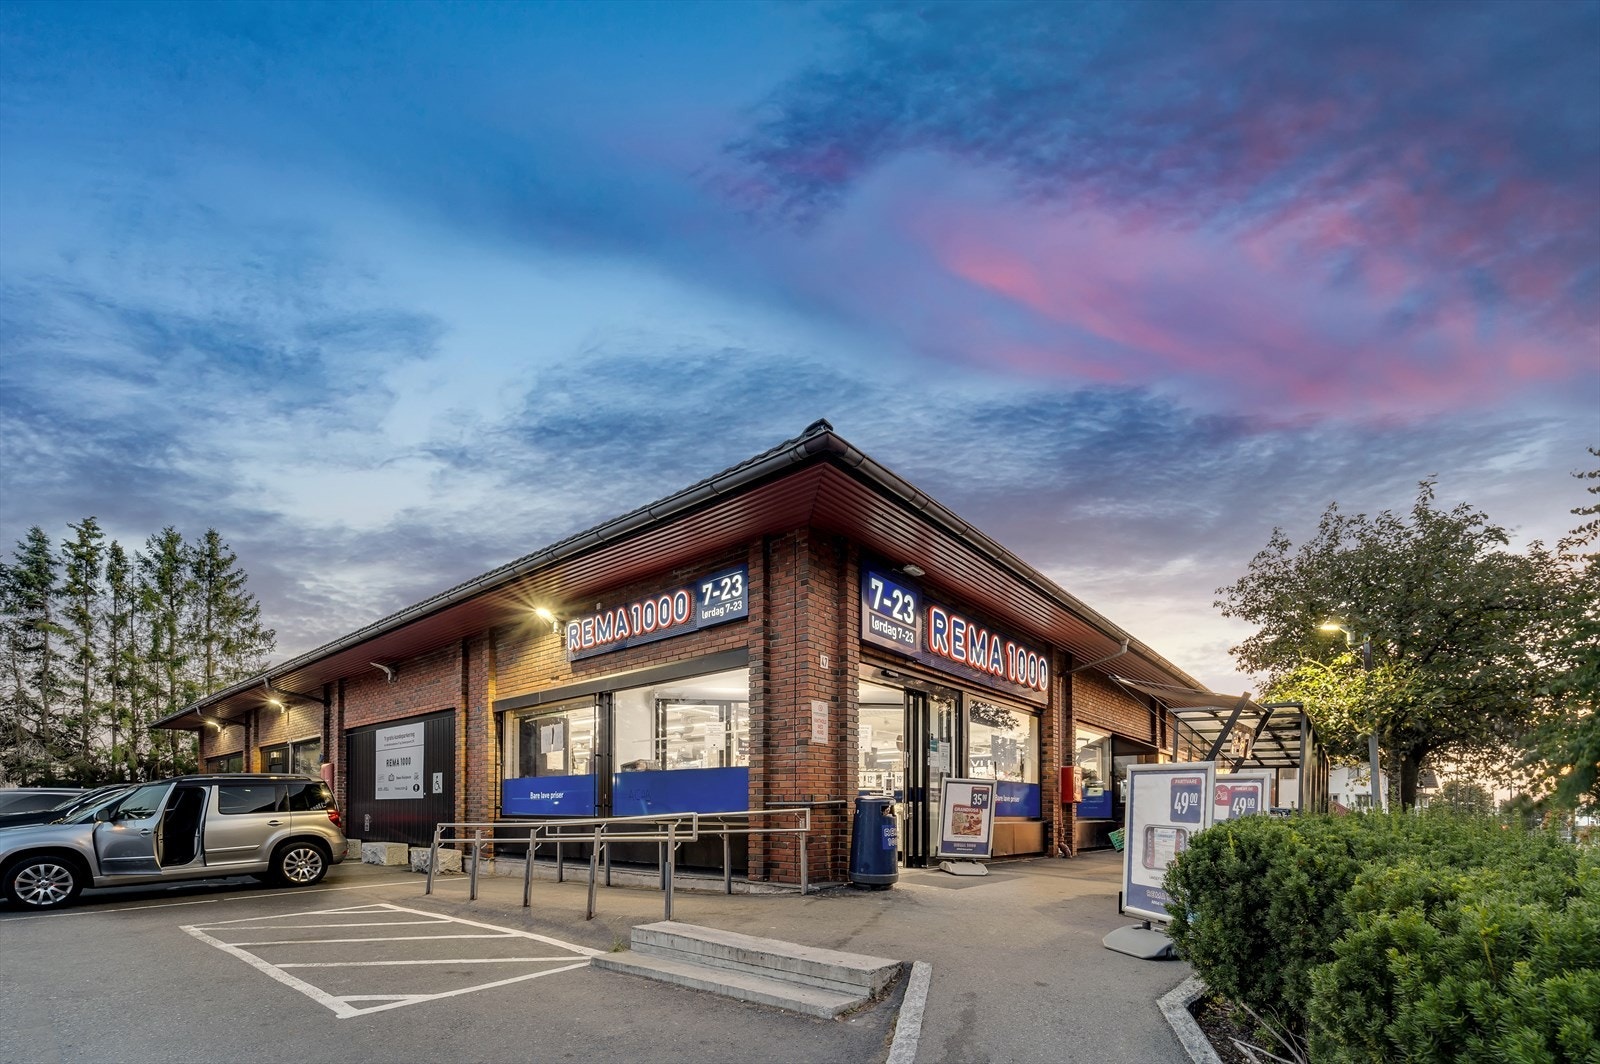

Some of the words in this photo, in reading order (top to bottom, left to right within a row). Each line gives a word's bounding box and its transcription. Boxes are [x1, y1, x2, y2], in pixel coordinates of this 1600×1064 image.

[702, 574, 742, 606] 7-23
[871, 578, 915, 624] 7-23
[567, 607, 631, 650] REMA
[631, 590, 692, 635] 1000
[701, 603, 724, 619] lørdag
[725, 600, 743, 613] 7-23
[871, 615, 897, 640] lørdag
[897, 628, 914, 644] 7-23
[928, 605, 1004, 677] REMA
[1005, 641, 1048, 692] 1000
[386, 758, 400, 767] REMA
[400, 757, 411, 766] 1000
[530, 791, 540, 799] Bare
[550, 791, 564, 800] priser
